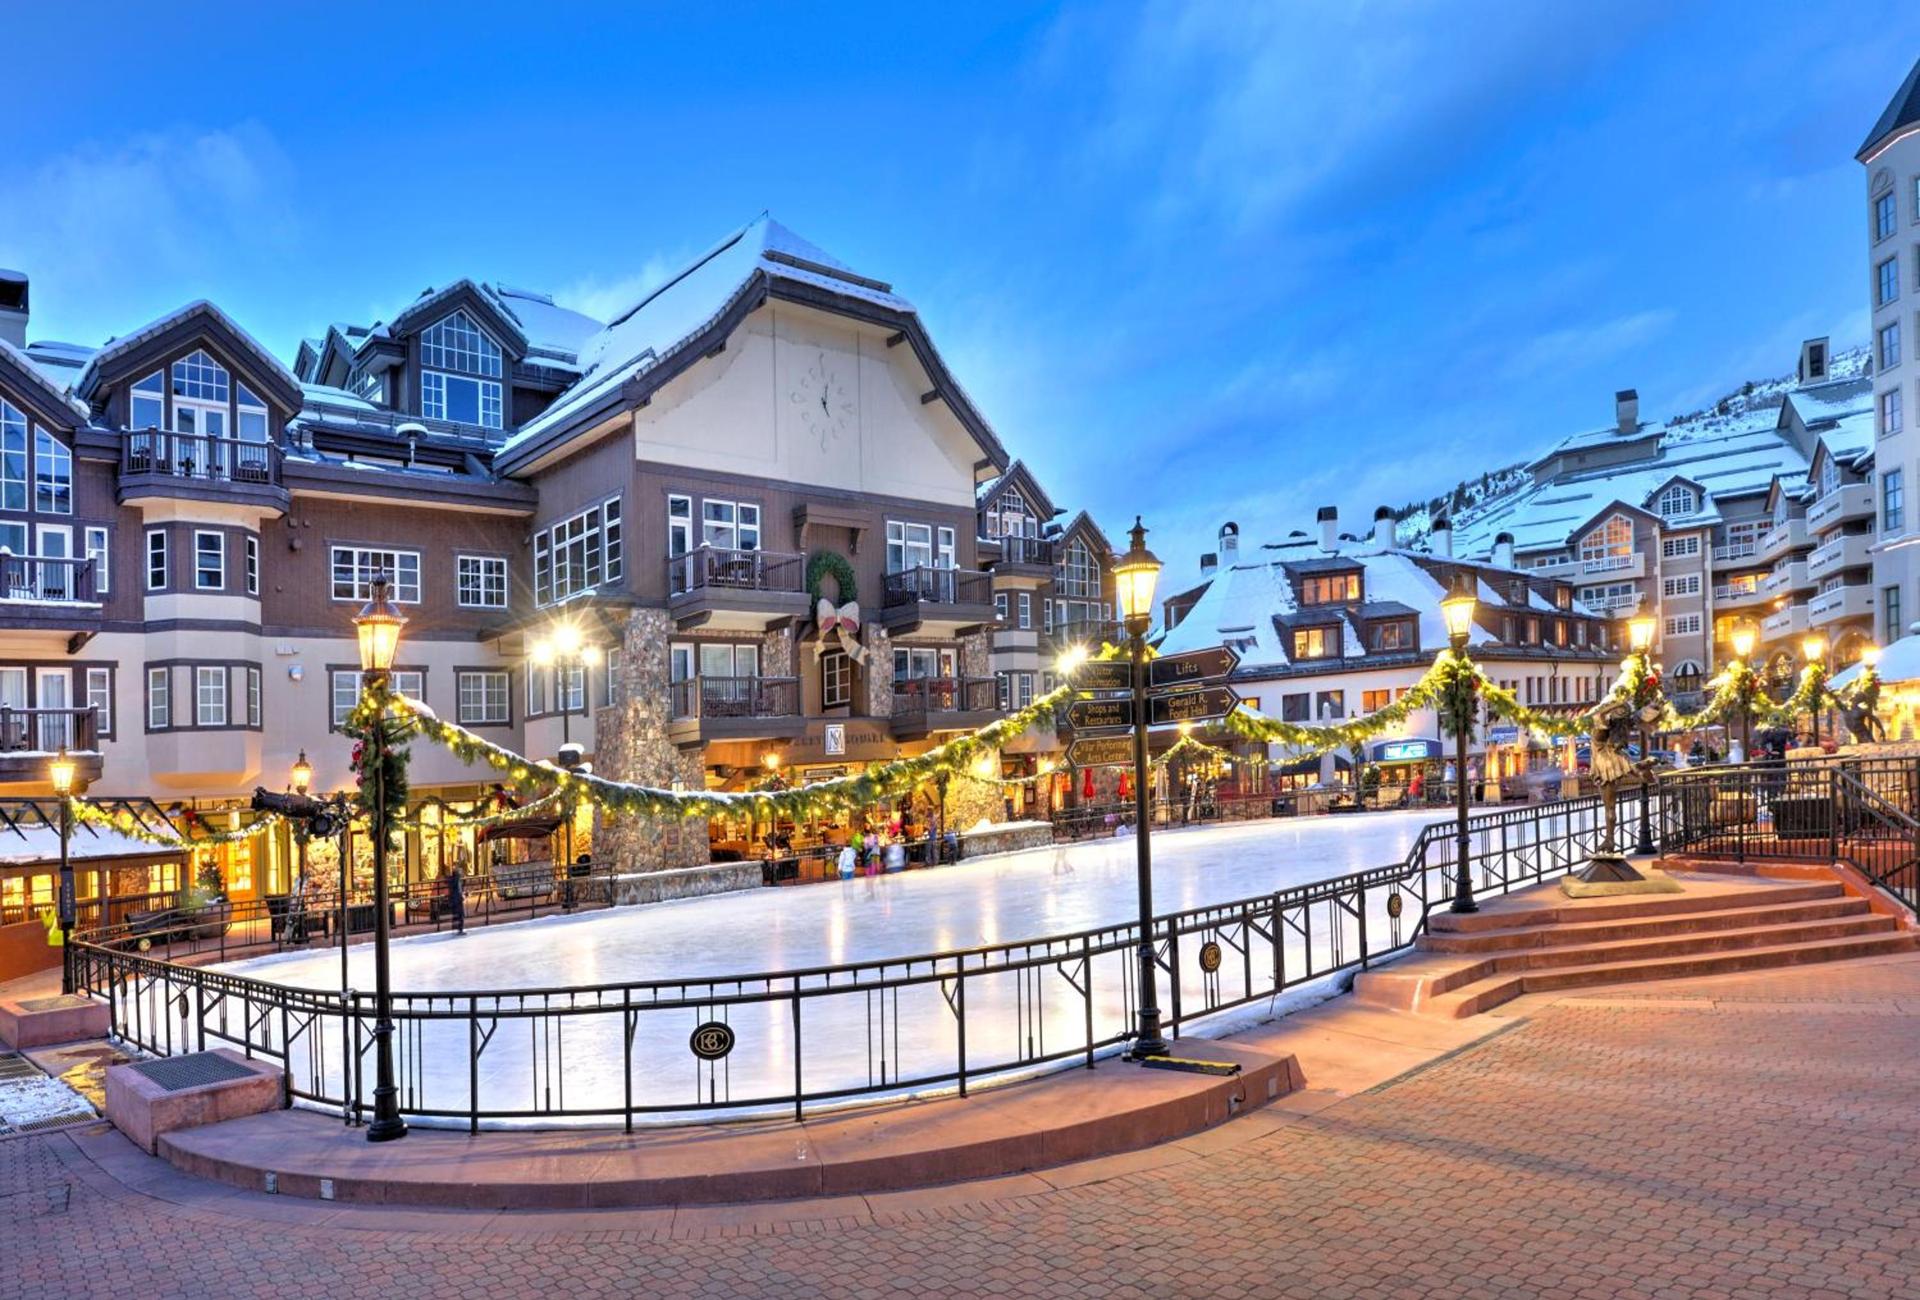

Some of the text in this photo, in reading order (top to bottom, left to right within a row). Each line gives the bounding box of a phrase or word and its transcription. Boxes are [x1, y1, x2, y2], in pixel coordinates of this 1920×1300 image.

[1175, 664, 1198, 676] Lifts
[1168, 696, 1195, 708] Gerald
[1169, 704, 1208, 721] Ford Hall
[1103, 750, 1126, 762] Center
